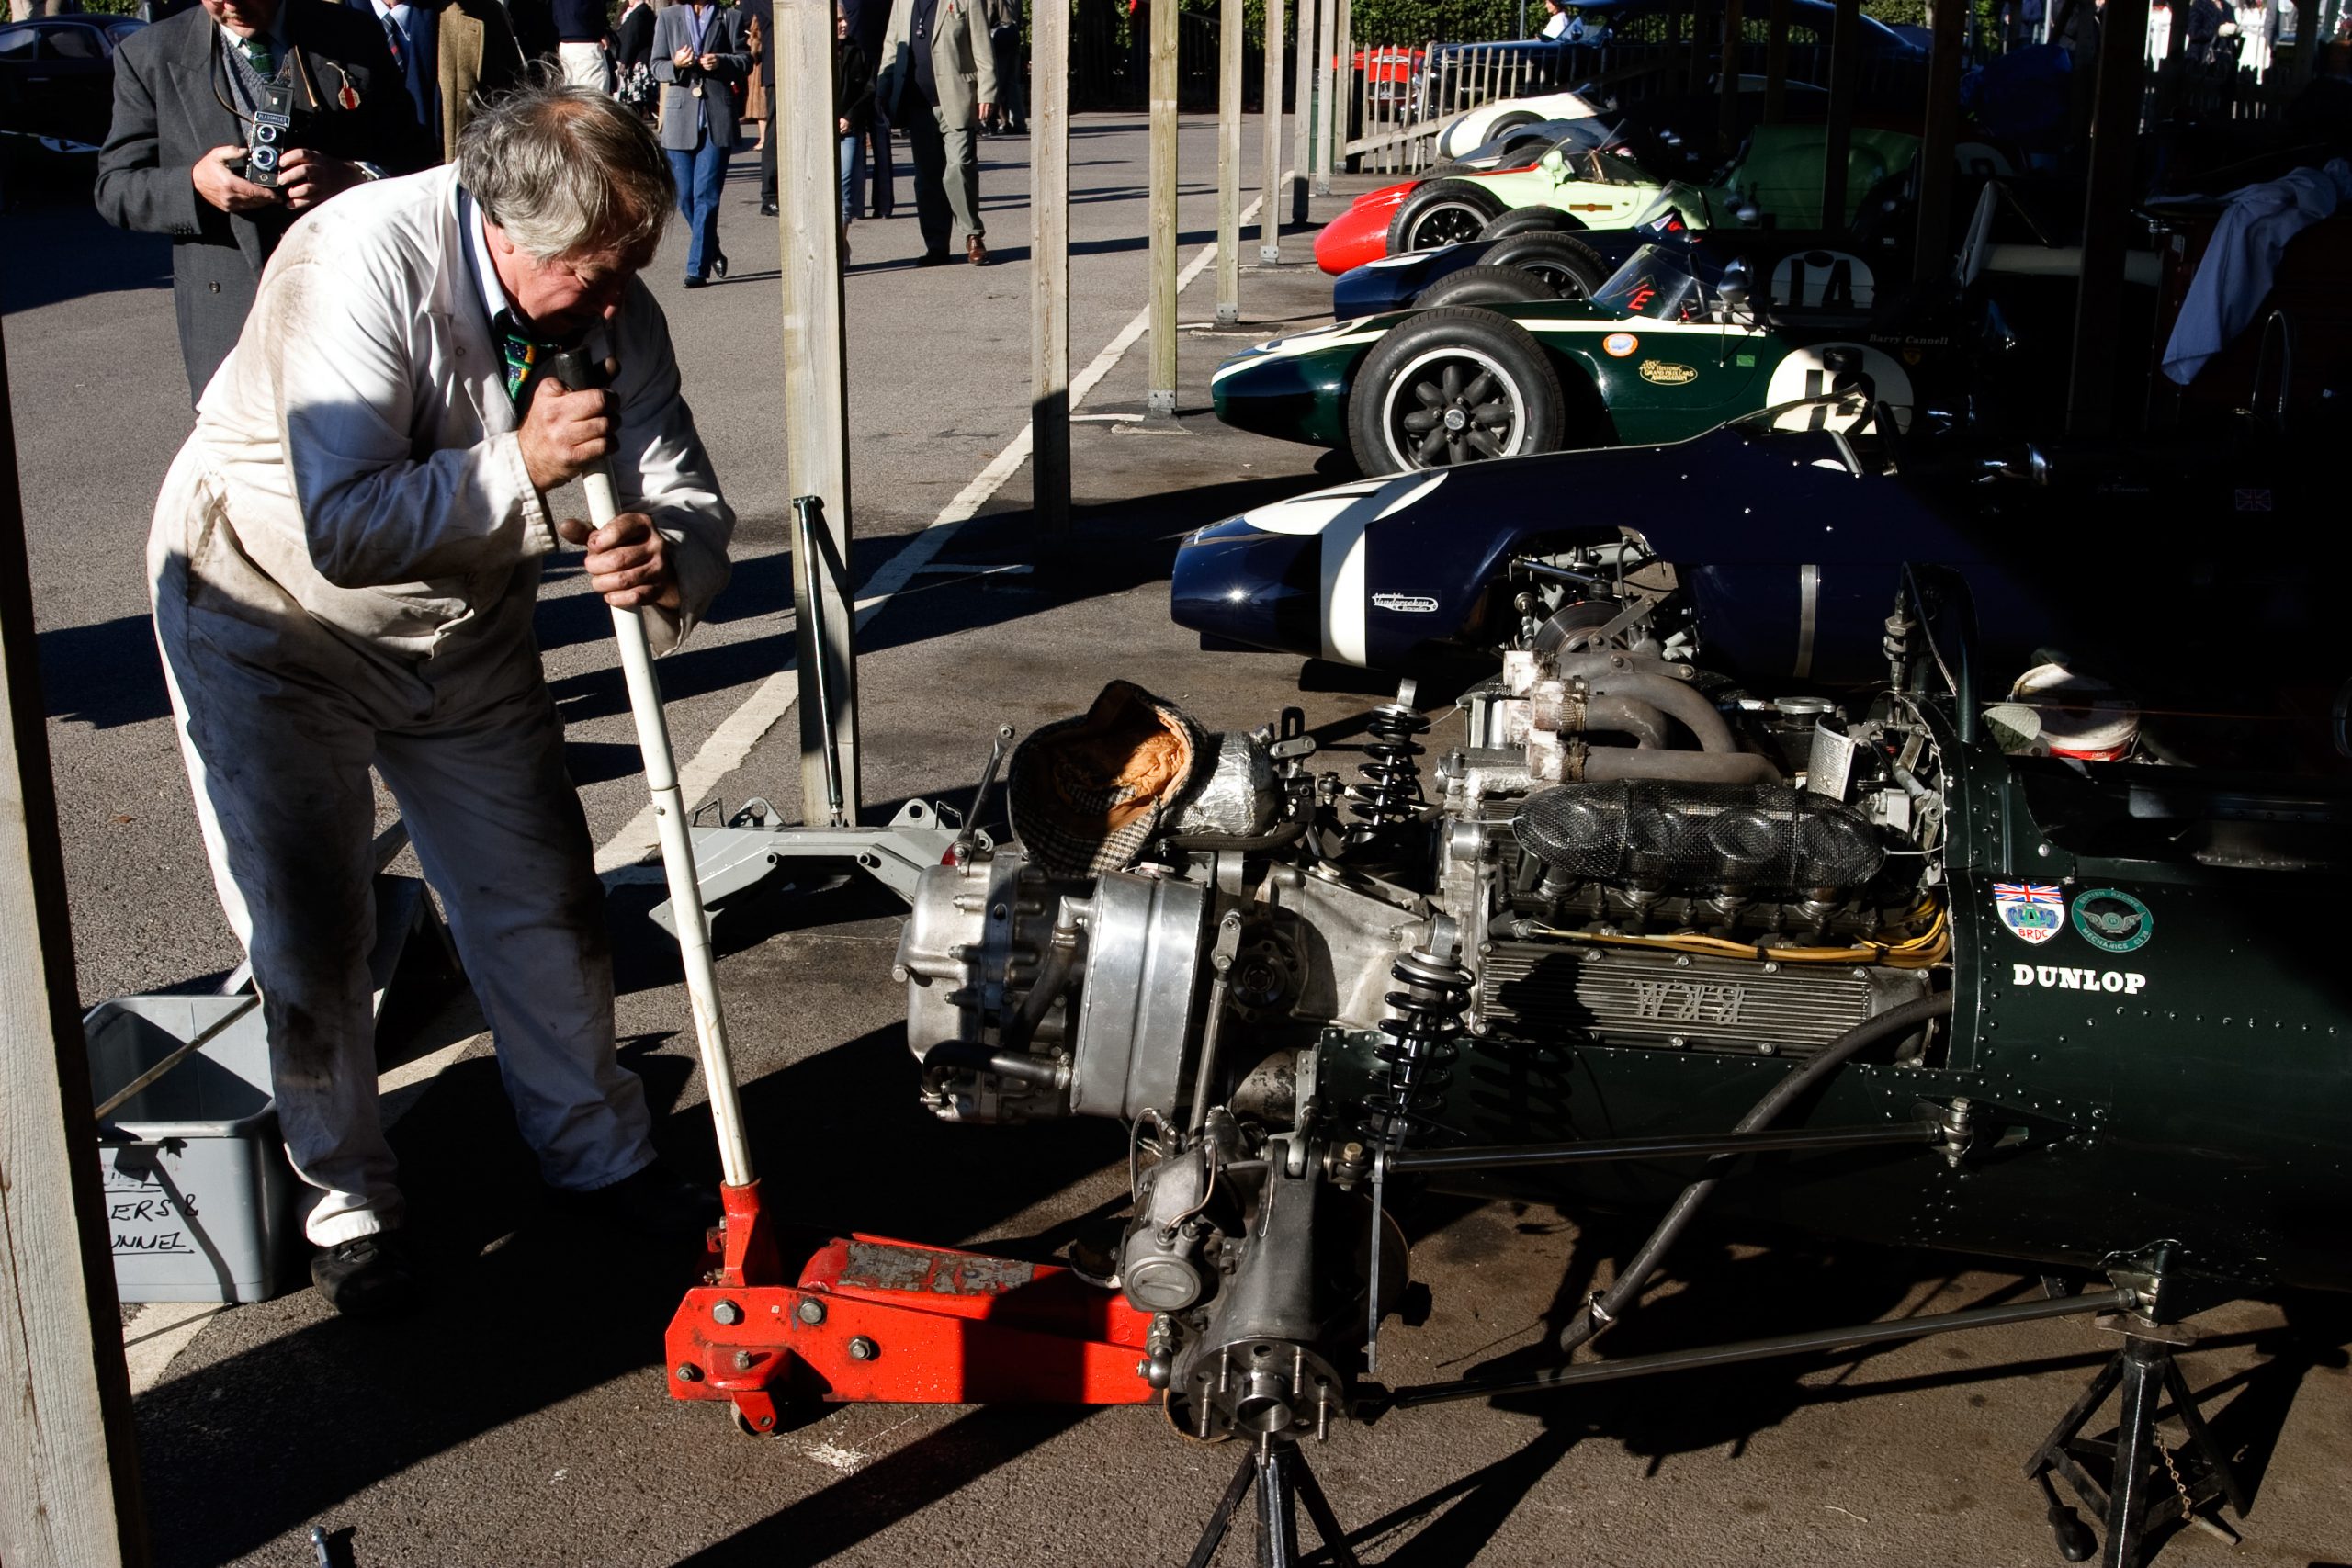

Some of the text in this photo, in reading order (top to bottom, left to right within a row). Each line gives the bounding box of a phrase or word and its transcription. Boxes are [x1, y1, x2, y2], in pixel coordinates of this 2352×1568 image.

[1868, 333, 1949, 345] Barry Cannell
[2080, 890, 2140, 908] BRITISH RACING
[2018, 928, 2048, 941] BRDC
[2081, 927, 2149, 950] MECHANICS CLUB
[2013, 964, 2147, 995] DUNLOP
[184, 1193, 199, 1217] &
